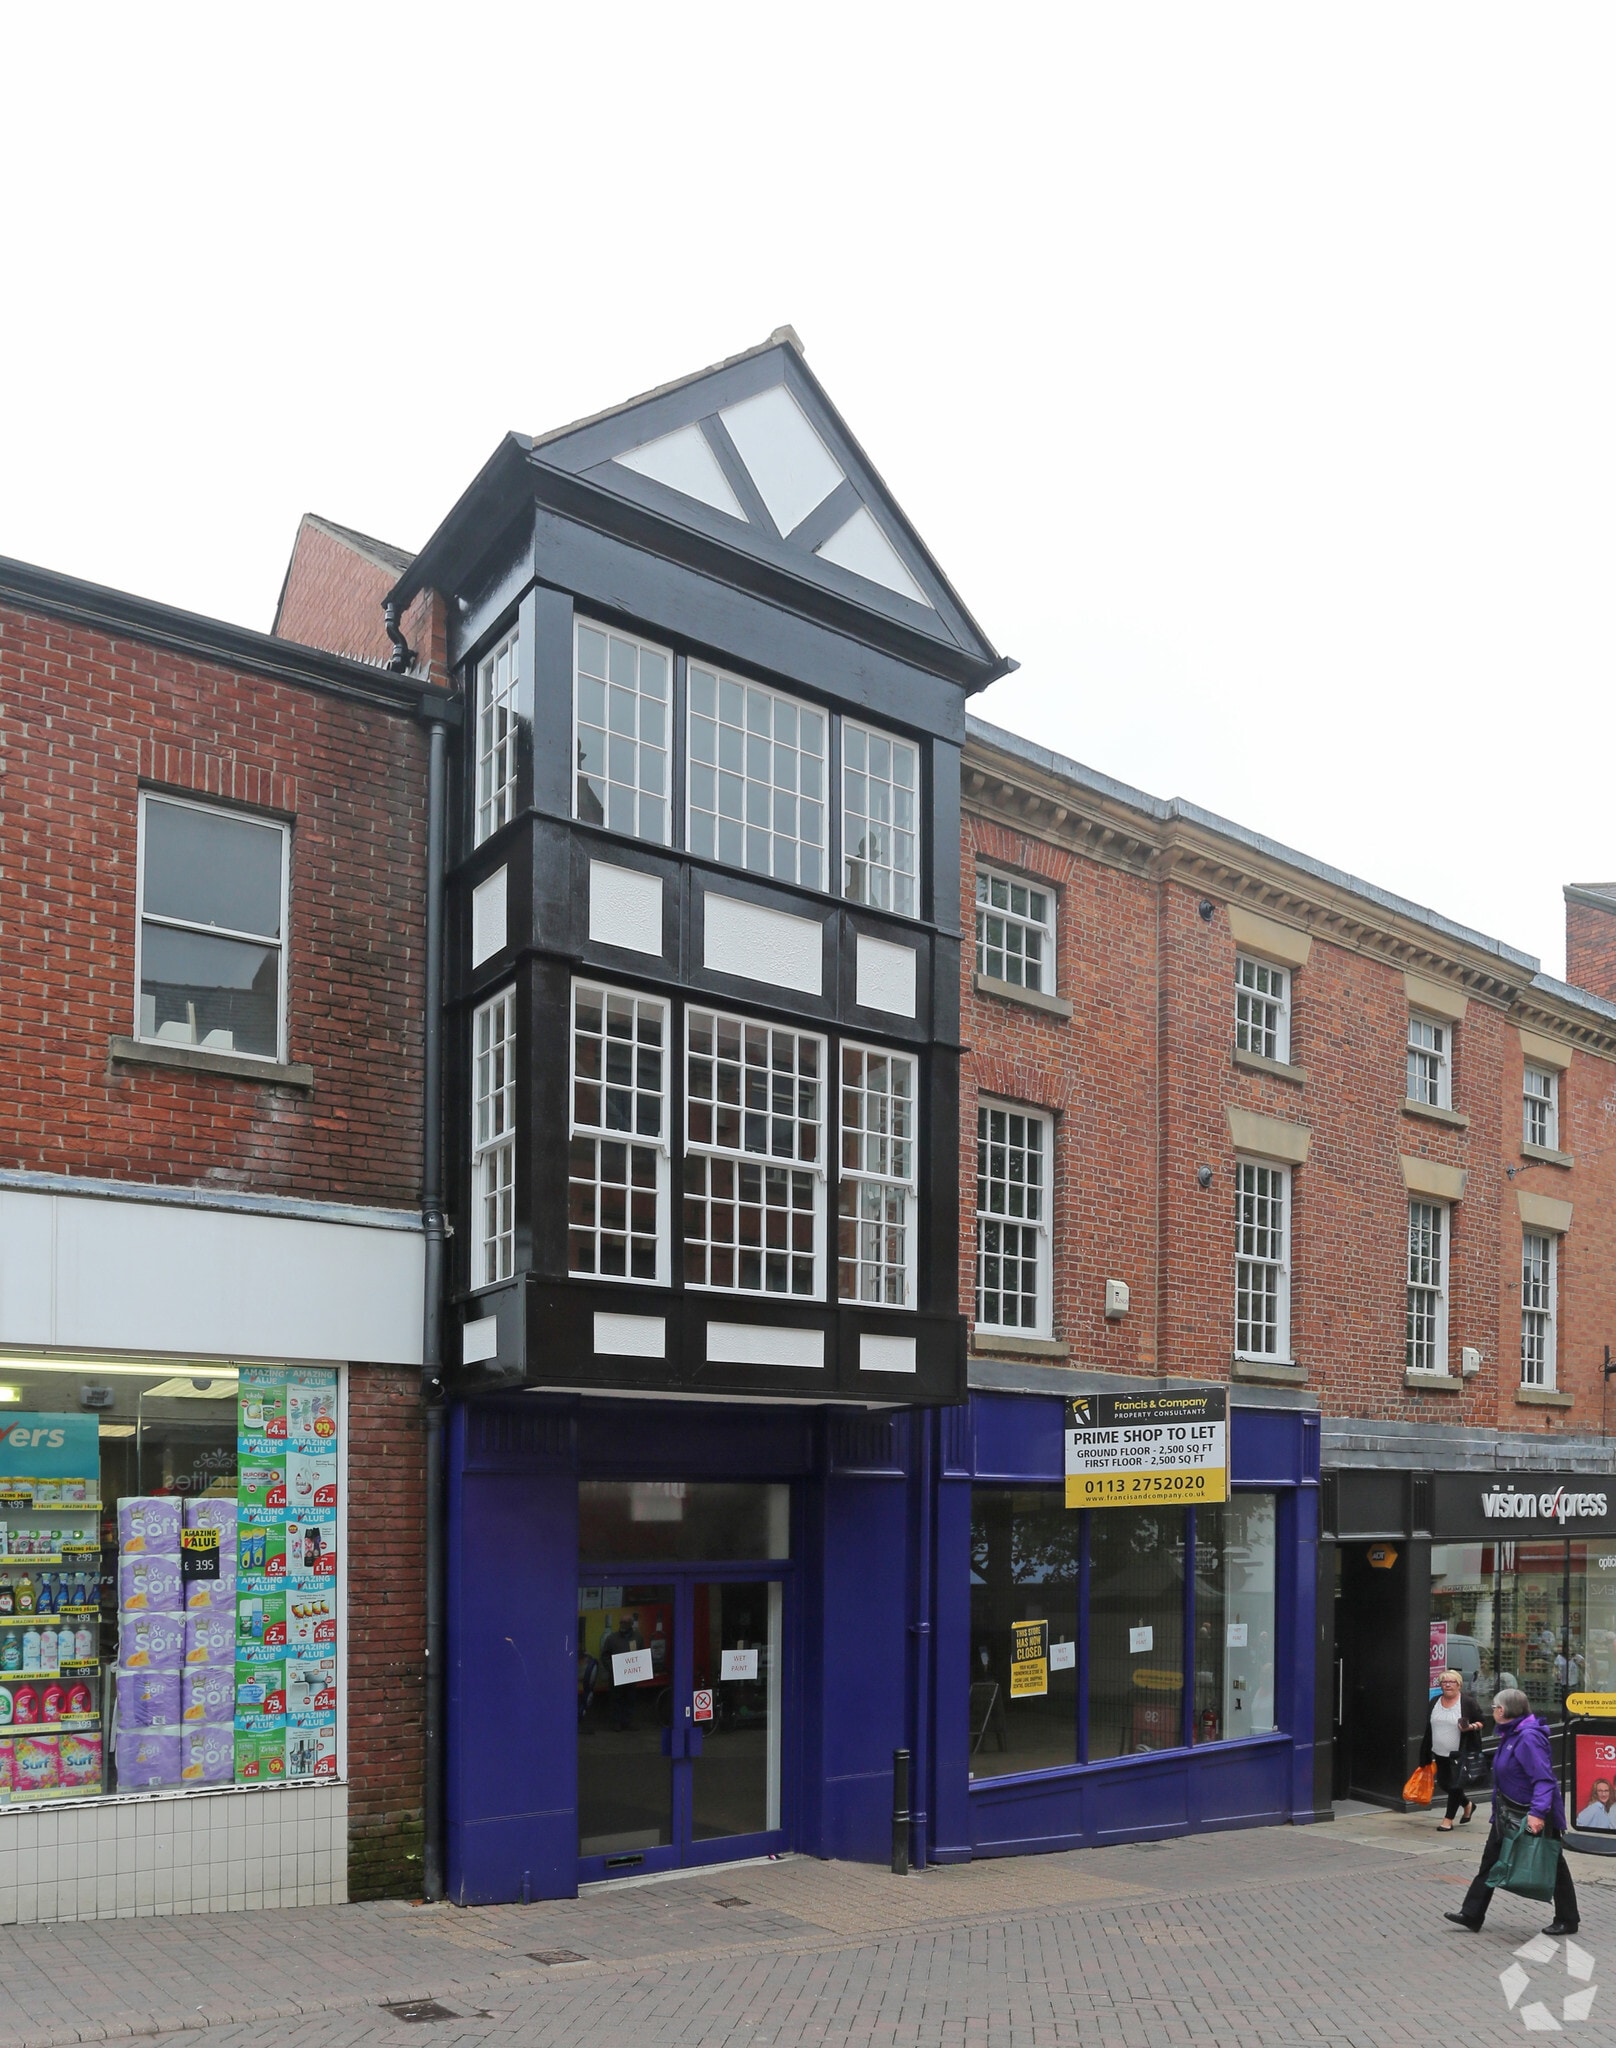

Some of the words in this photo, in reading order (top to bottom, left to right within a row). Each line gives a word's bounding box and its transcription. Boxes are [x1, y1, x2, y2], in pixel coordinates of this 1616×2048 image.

[244, 1369, 285, 1377] AMAZING
[292, 1370, 333, 1378] AMAZING
[250, 1376, 278, 1385] VALUE
[298, 1377, 327, 1386] VALUE
[1114, 1400, 1148, 1410] Francis
[1149, 1400, 1156, 1409] &
[1158, 1398, 1208, 1408] Company
[1114, 1411, 1151, 1419] PROPERTY
[1153, 1408, 1206, 1417] CONSULTANTS
[316, 1422, 334, 1435] 99p
[1074, 1431, 1119, 1445] PRIME
[1123, 1429, 1163, 1443] SHOP
[1167, 1427, 1186, 1440] TO
[1191, 1425, 1216, 1439] LET
[249, 1444, 277, 1454] VALUE
[298, 1444, 326, 1453] VALUE
[1077, 1448, 1117, 1458] GROUND
[1120, 1447, 1150, 1456] FLOOR
[1159, 1445, 1184, 1455] 2,500
[1186, 1444, 1200, 1454] SQ
[1202, 1443, 1213, 1452] FT
[1085, 1459, 1109, 1468] FIRST
[1112, 1457, 1142, 1467] FLOOR
[1151, 1455, 1176, 1466] 2,500
[1178, 1455, 1192, 1464] SQ
[1194, 1454, 1204, 1463] FT
[1085, 1480, 1125, 1493] 0113
[1132, 1476, 1205, 1491] 2752020
[315, 1493, 334, 1503] £2.99
[1085, 1490, 1206, 1502] www.francisandcompany.co.uk
[1481, 1484, 1537, 1518] vision
[1539, 1485, 1608, 1525] express
[249, 1514, 277, 1522] VALUE
[297, 1513, 325, 1522] VALUE
[130, 1517, 180, 1537] Soft
[184, 1536, 217, 1549] VALUE
[76, 1553, 92, 1562] 2.99
[195, 1559, 214, 1571] 3.95
[196, 1573, 237, 1593] Sof
[291, 1575, 331, 1583] AMAZING
[132, 1575, 182, 1595] Soft
[248, 1582, 276, 1591] VALUE
[297, 1581, 325, 1590] VALUE
[77, 1614, 91, 1622] 1.99
[1016, 1629, 1028, 1638] THIS
[1028, 1626, 1041, 1636] STORE
[134, 1632, 184, 1652] Soft
[194, 1629, 236, 1649] Sof
[1016, 1637, 1029, 1649] HAS
[1029, 1635, 1041, 1646] NOW
[291, 1643, 331, 1651] AMAZING
[247, 1652, 275, 1660] VALUE
[297, 1649, 325, 1658] VALUE
[1017, 1645, 1042, 1660] CLOSED
[1430, 1644, 1445, 1662] 39
[624, 1656, 638, 1664] WET
[77, 1668, 90, 1676] 1.99
[623, 1666, 642, 1675] PAINT
[240, 1714, 281, 1722] AMAZING
[291, 1711, 331, 1720] AMAZING
[246, 1721, 274, 1730] VALUE
[297, 1718, 325, 1727] VALUE
[23, 1757, 50, 1770] Surf
[66, 1754, 94, 1767] Surf
